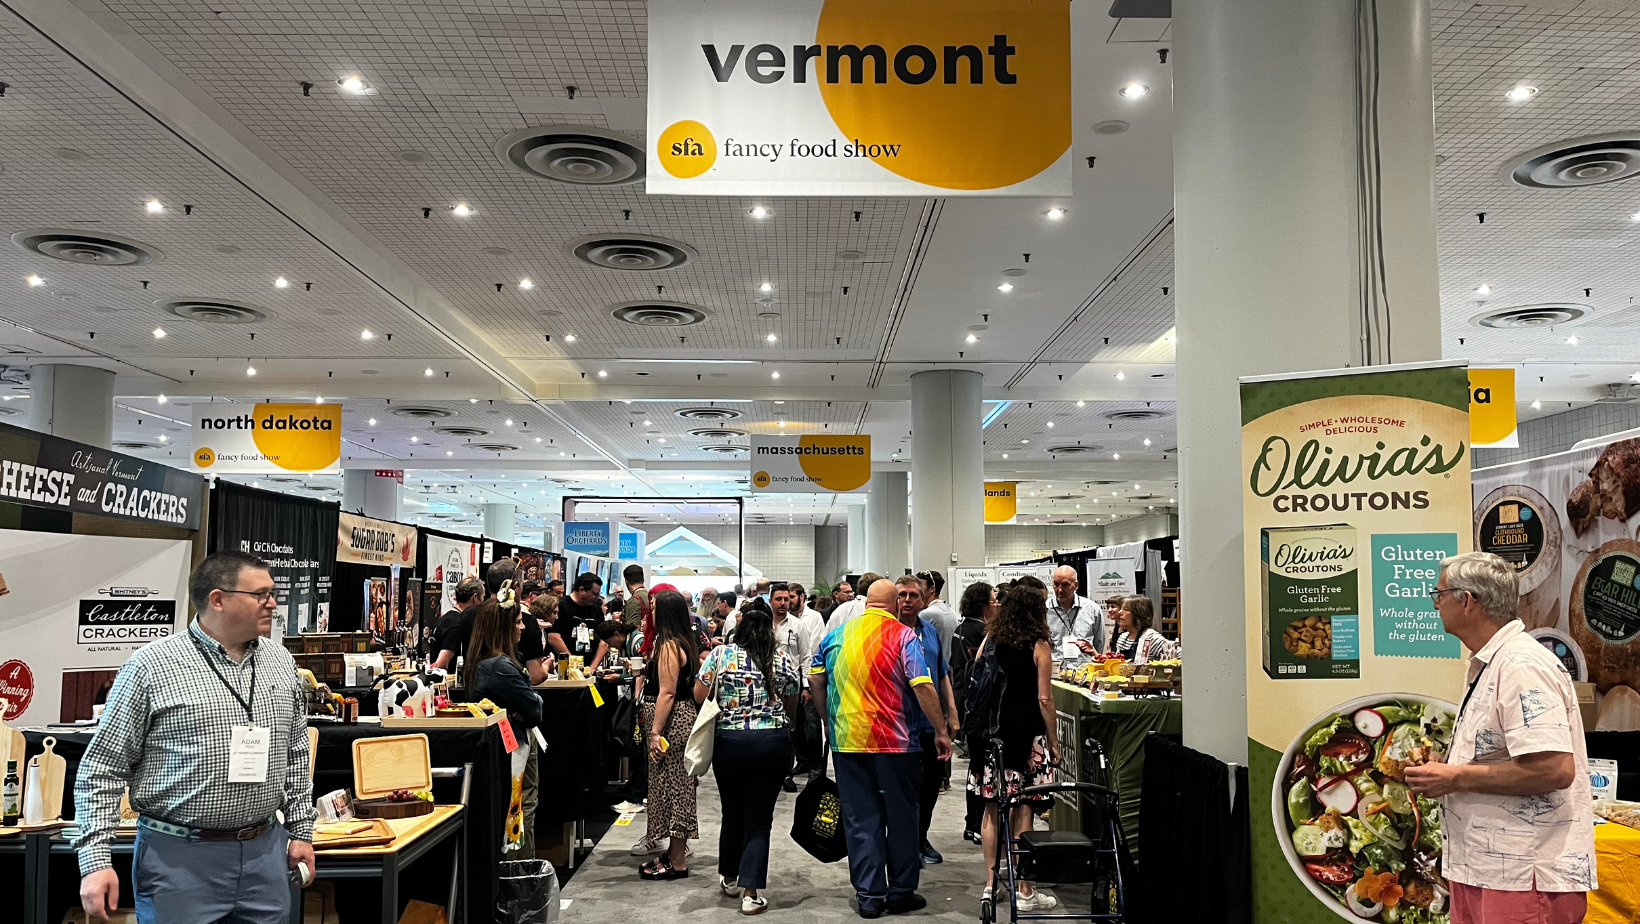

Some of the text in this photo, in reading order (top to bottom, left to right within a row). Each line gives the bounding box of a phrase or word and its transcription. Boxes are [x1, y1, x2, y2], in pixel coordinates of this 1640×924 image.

[700, 34, 1018, 85] vermont
[671, 137, 902, 162] sfa fancy food show
[201, 414, 332, 431] north dakota
[1299, 416, 1406, 433] SIMPLE WHOLESOME
[1325, 426, 1378, 436] DELICIOUS
[757, 443, 864, 456] massachusetts
[198, 453, 281, 462] sfa fancy food show
[70, 450, 144, 481] Artisanal Vermont
[1250, 434, 1465, 497] Olivia's
[0, 460, 188, 524] HEESE and CRACKERS
[984, 489, 1011, 497] lands
[1272, 490, 1430, 513] CROUTONS
[566, 535, 607, 545] ORCHARDS
[574, 529, 603, 537] LIBERTY
[1492, 533, 1528, 546] CHEDDAR
[1274, 543, 1354, 568] Olivia's
[1381, 544, 1447, 561] Gluten
[1285, 564, 1343, 573] CROUTONS
[1393, 564, 1436, 579] Free
[1287, 585, 1342, 594] Gluten Free
[1384, 581, 1433, 598] Garli
[1300, 594, 1329, 603] Garlic
[85, 603, 170, 622] Castleton
[1379, 607, 1441, 620] Whole grai
[1395, 619, 1438, 630] without
[83, 627, 169, 639] CRACKERS
[1388, 629, 1445, 643] the gluten
[9, 665, 21, 679] A
